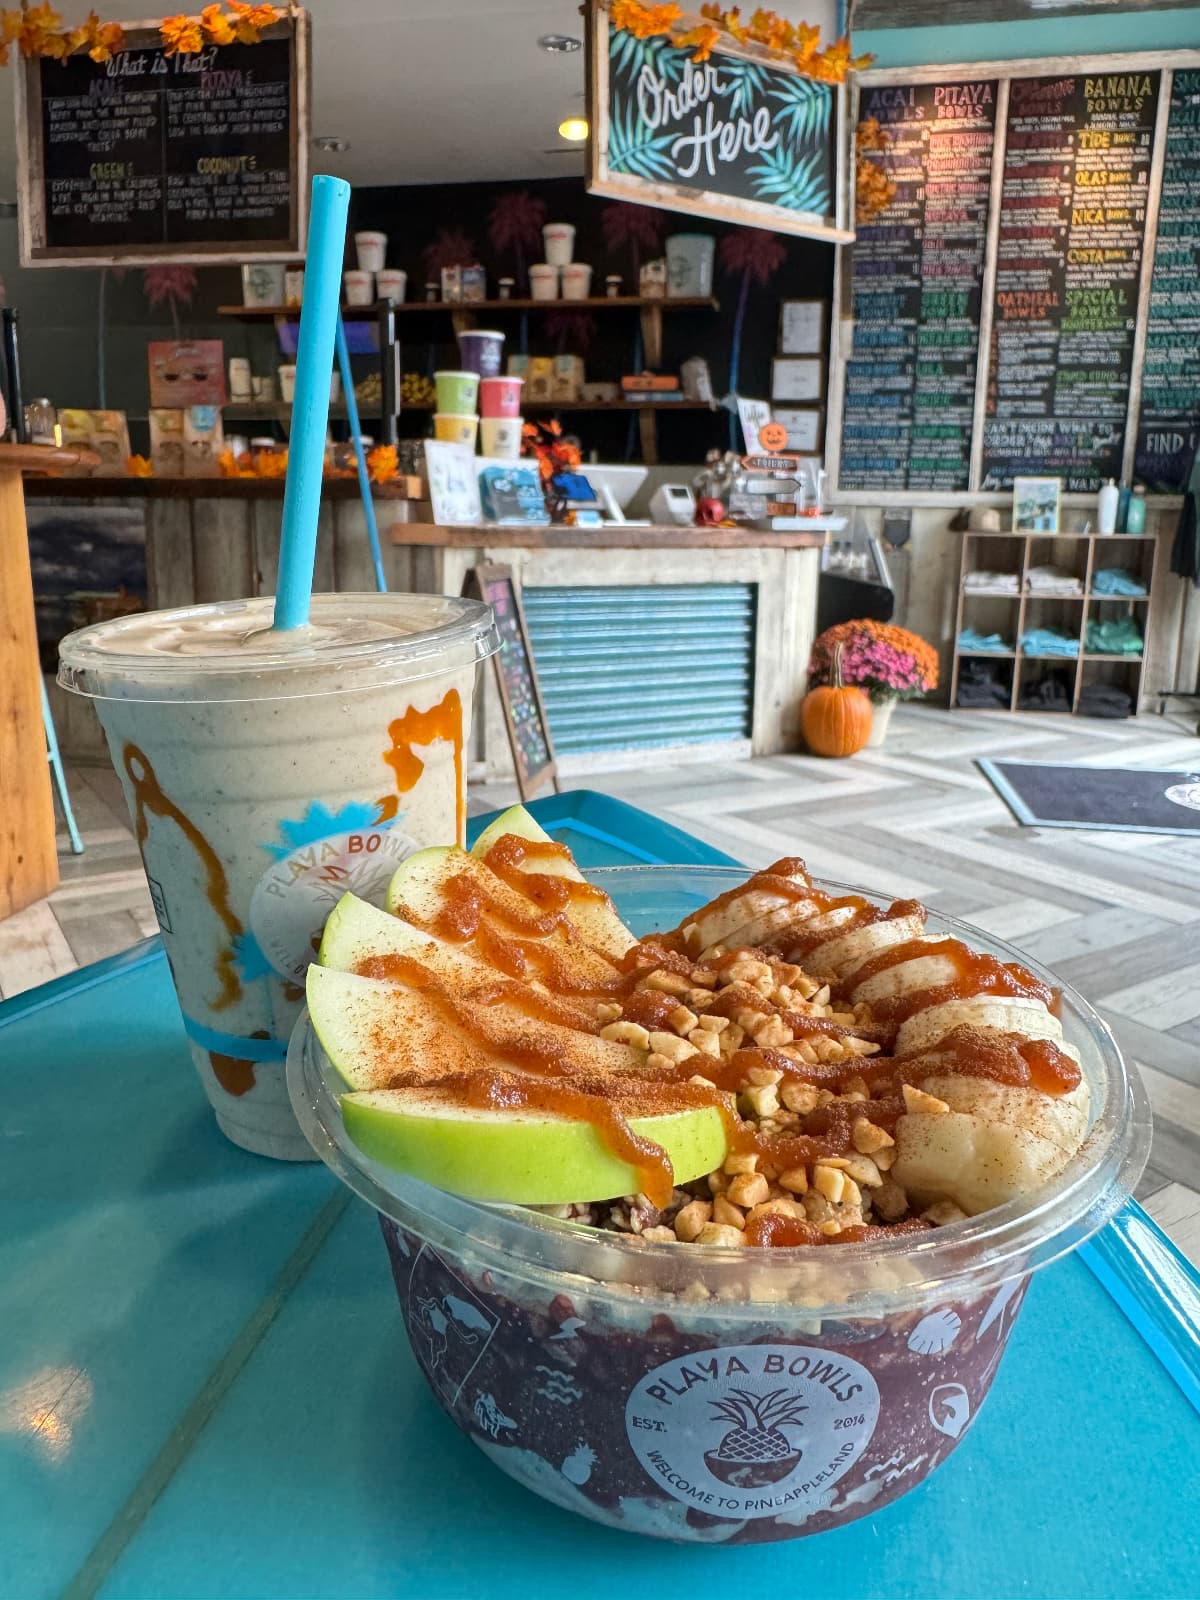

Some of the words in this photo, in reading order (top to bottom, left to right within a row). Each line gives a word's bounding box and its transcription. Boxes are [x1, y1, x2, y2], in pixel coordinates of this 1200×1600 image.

[105, 52, 147, 77] What
[151, 51, 168, 75] is
[637, 58, 726, 129] Order
[934, 84, 993, 106] PITAYA
[1084, 76, 1153, 98] BANANA
[869, 87, 916, 108] ACAI
[1086, 97, 1144, 113] BOWLS
[937, 104, 984, 119] BOWLS
[672, 101, 780, 178] Here
[1079, 131, 1111, 148] TIDE
[90, 162, 125, 180] GREEN
[197, 156, 247, 174] COCONUT
[1075, 170, 1107, 185] OLAS
[1072, 208, 1104, 224] NICA
[1067, 249, 1105, 263] COSTA
[997, 290, 1059, 307] OATMEAL
[1064, 288, 1128, 306] SPECIAL
[1003, 306, 1047, 319] BOWLS
[1070, 305, 1118, 319] BOWLS
[1146, 432, 1184, 455] FIND
[266, 841, 339, 899] PLAYA
[348, 834, 411, 862] BOWL
[645, 1355, 750, 1406] PLAYA
[763, 1353, 863, 1403] BOWLS
[631, 1415, 668, 1434] EST.
[833, 1414, 866, 1431] 2014
[647, 1449, 715, 1505] WELCOME
[717, 1496, 740, 1511] TO
[744, 1441, 855, 1511] PINEAPPLELAND
